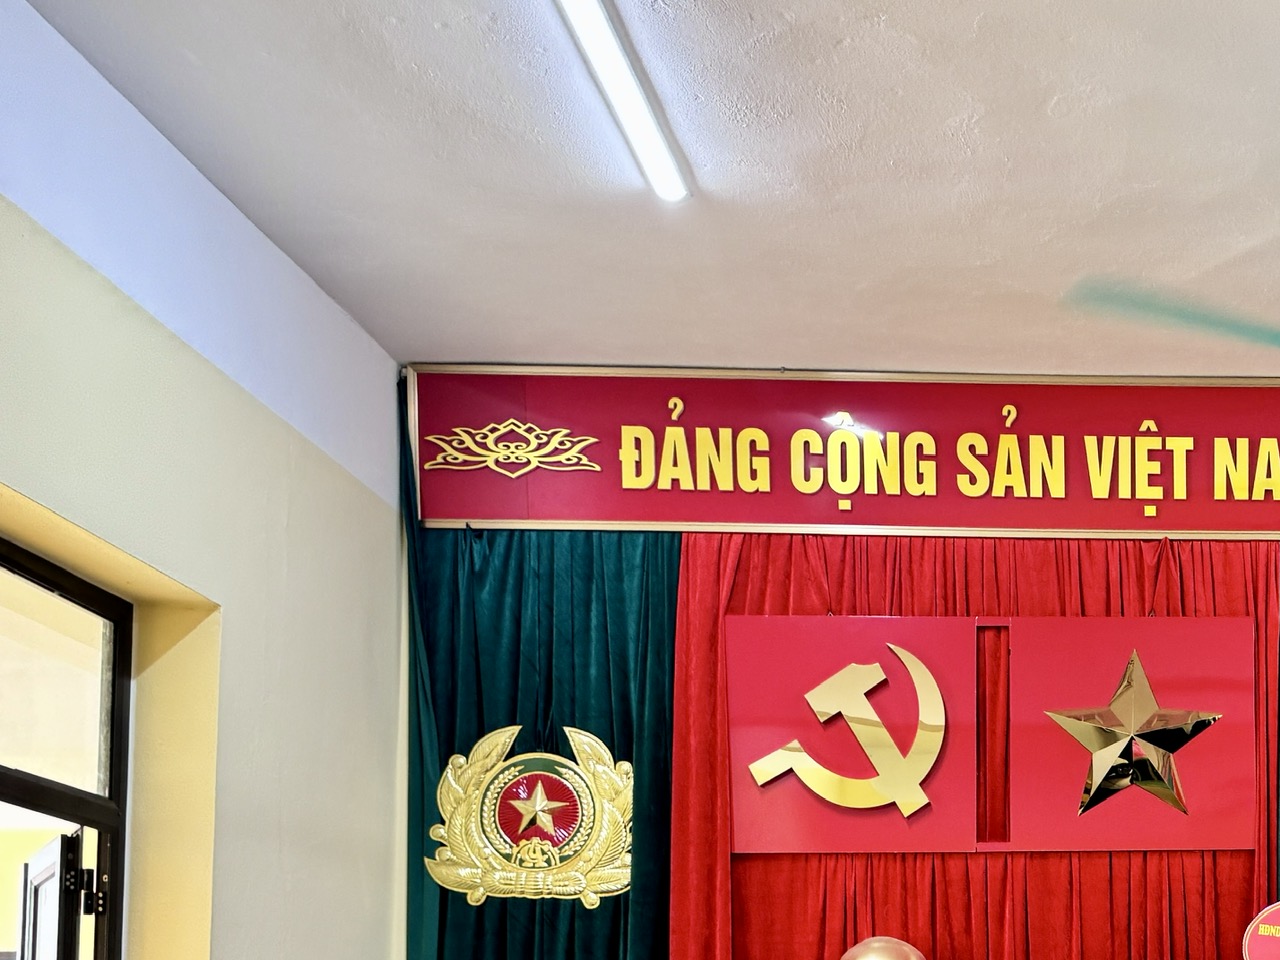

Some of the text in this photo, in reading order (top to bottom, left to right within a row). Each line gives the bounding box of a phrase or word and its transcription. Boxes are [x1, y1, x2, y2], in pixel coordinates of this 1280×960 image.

[619, 396, 771, 493] ĐẢNG
[790, 411, 938, 511] CỘNG
[956, 404, 1066, 499] SẢN
[1083, 419, 1194, 517] VIỆT
